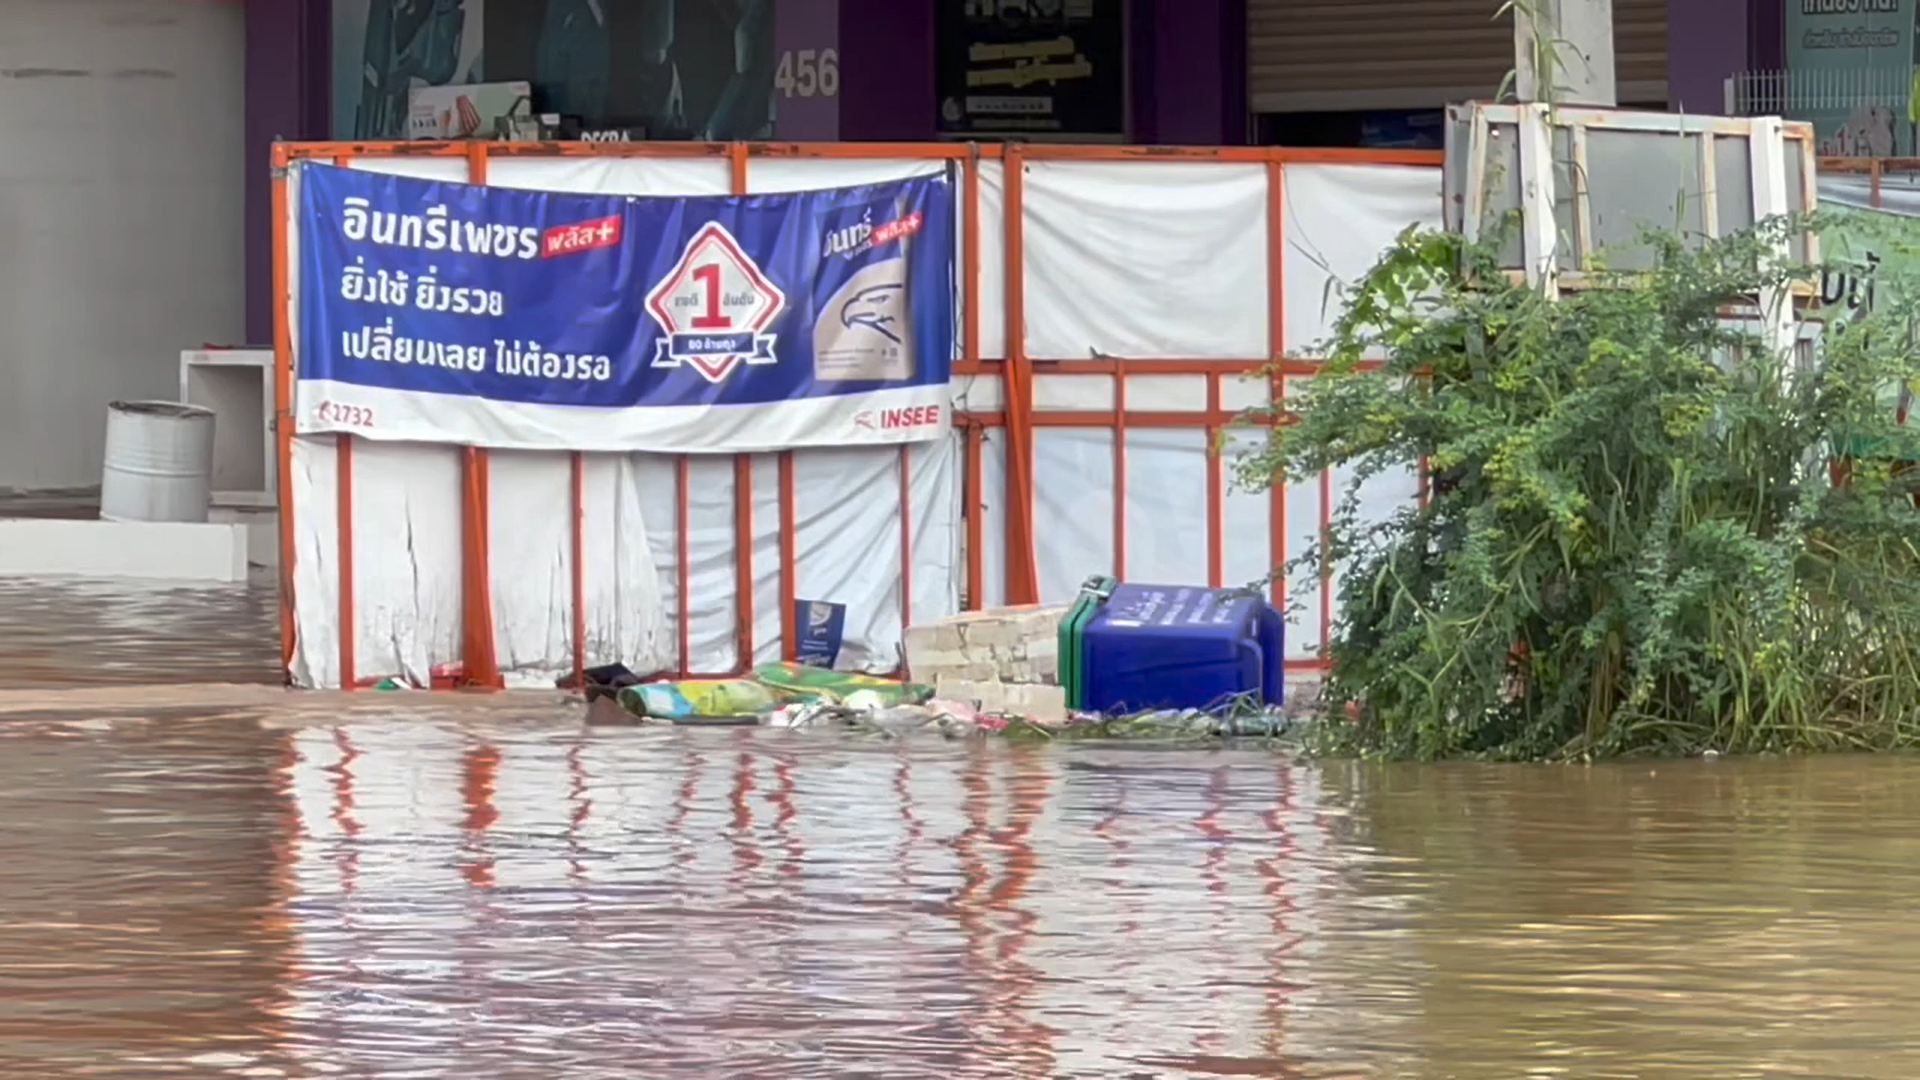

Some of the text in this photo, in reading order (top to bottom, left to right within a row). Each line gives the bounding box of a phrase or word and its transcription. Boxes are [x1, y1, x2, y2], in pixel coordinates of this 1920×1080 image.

[775, 49, 837, 96] 456
[343, 197, 538, 259] อินทรีเพชร
[341, 256, 504, 317] ยิ่งใช้ ยิ่งรวย
[692, 264, 732, 328] 1
[342, 317, 611, 381] เปลี่ยนเลย ไม่ต้องรอ
[334, 404, 373, 427] 1732
[882, 405, 939, 428] INSEE
